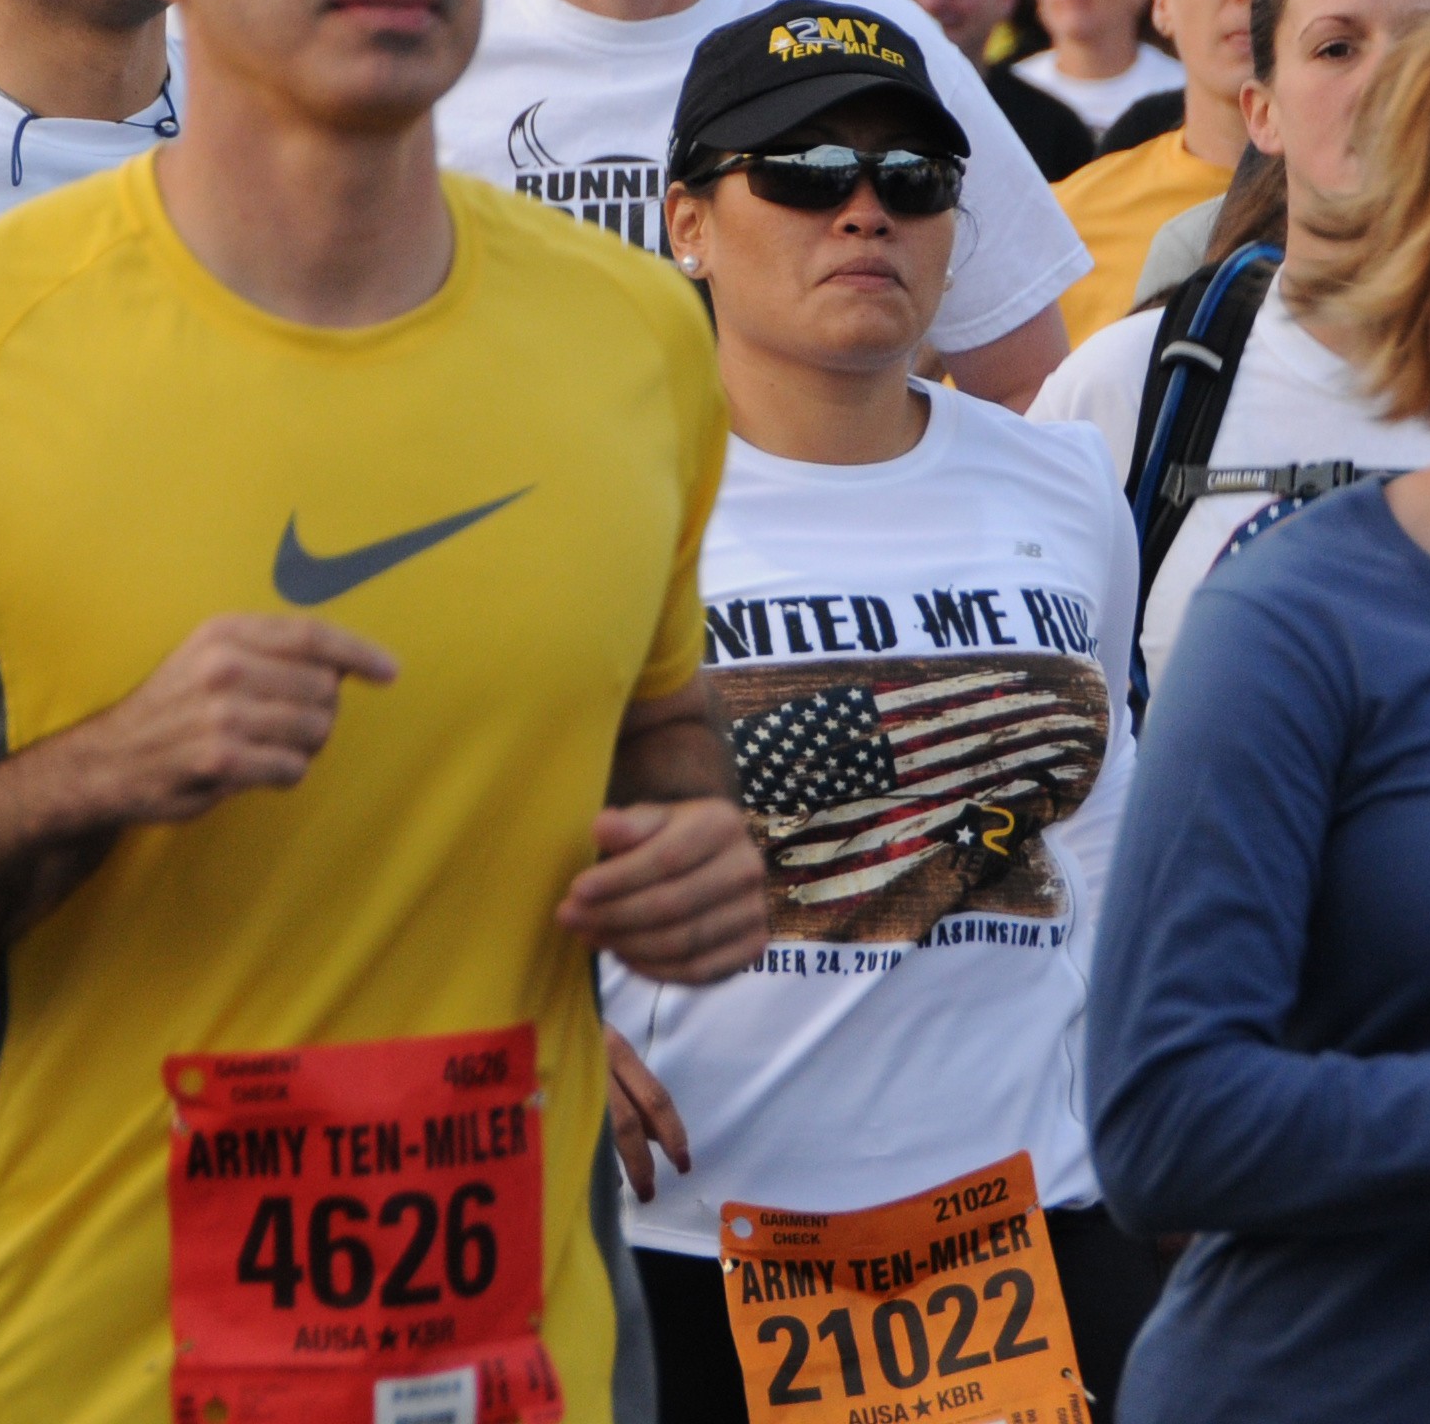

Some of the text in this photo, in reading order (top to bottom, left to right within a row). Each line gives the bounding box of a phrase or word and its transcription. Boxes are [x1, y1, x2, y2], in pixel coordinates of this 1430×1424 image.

[516, 168, 667, 201] RUNNI
[705, 595, 897, 664] NITED
[914, 584, 1016, 647] WE
[743, 949, 806, 977] OBER
[443, 1050, 510, 1088] 4626
[186, 1103, 529, 1181] ARMY TEN-MILER
[760, 1213, 829, 1228] GARMENT
[933, 1178, 1009, 1223] 21022
[237, 1182, 497, 1309] 4626
[741, 1213, 1032, 1304] ARMY TEN-MILER
[773, 1232, 820, 1245] CHECK
[295, 1318, 456, 1352] AUSA KBR
[757, 1268, 1049, 1406] 21022
[849, 1382, 984, 1424] AUSA KBR
